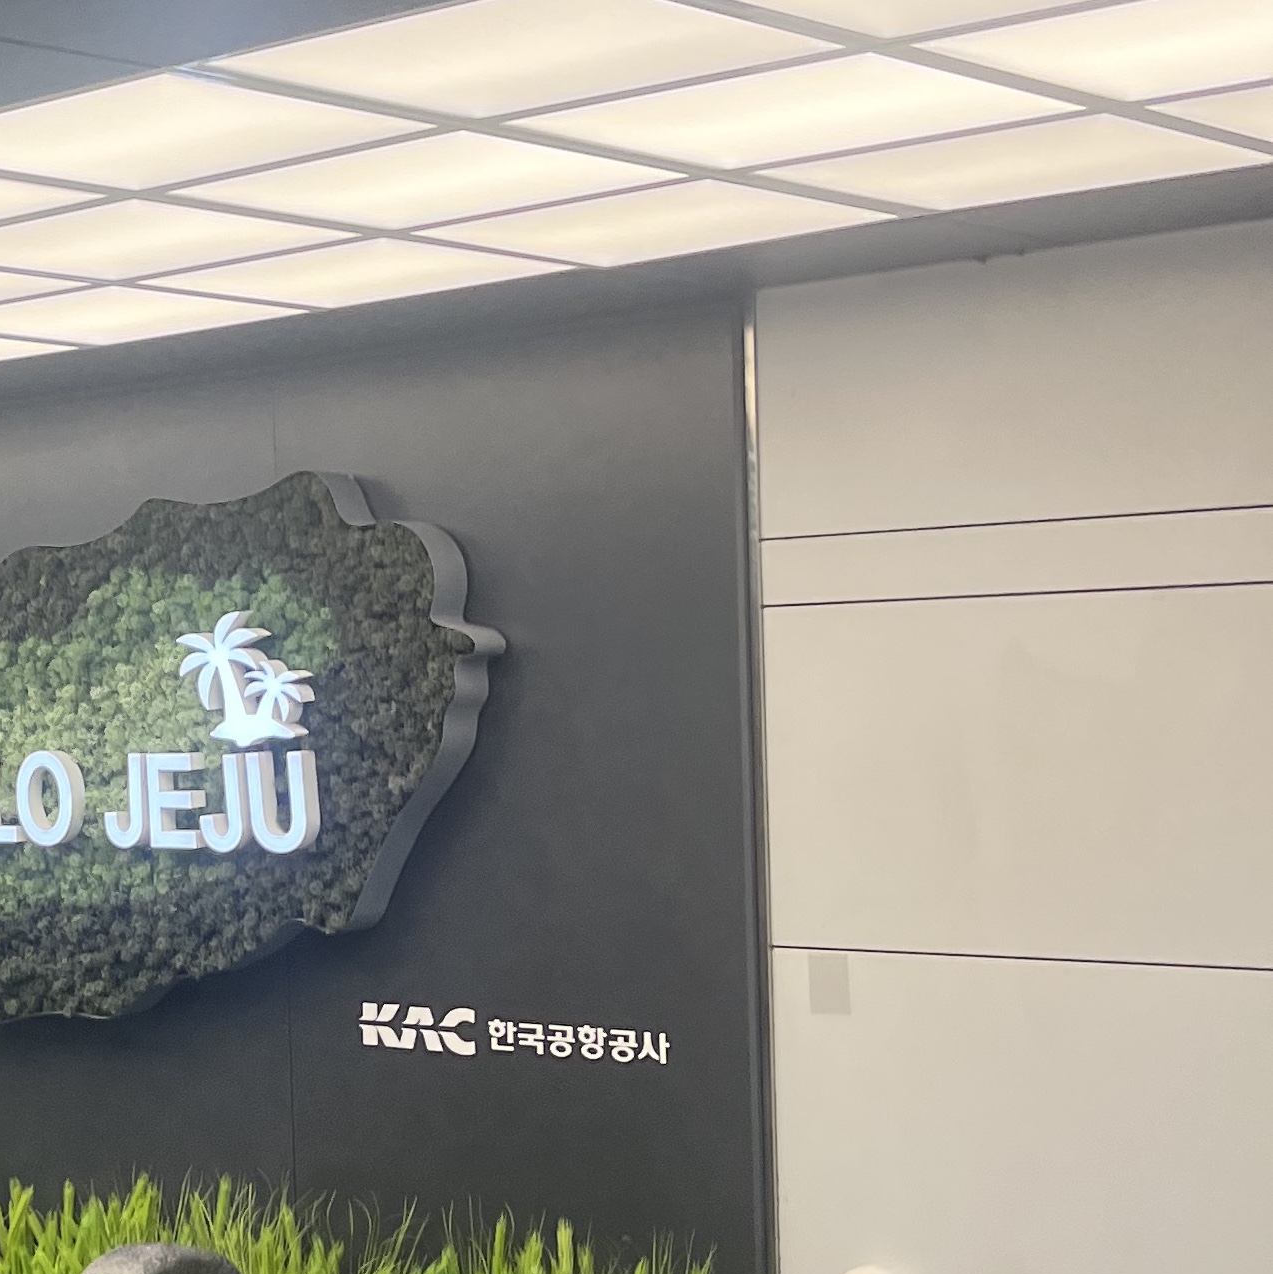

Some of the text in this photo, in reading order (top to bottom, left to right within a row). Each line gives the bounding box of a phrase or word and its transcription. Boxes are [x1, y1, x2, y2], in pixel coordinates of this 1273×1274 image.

[104, 749, 321, 855] JEJU
[359, 1001, 670, 1065] KAC 한국공항공사
